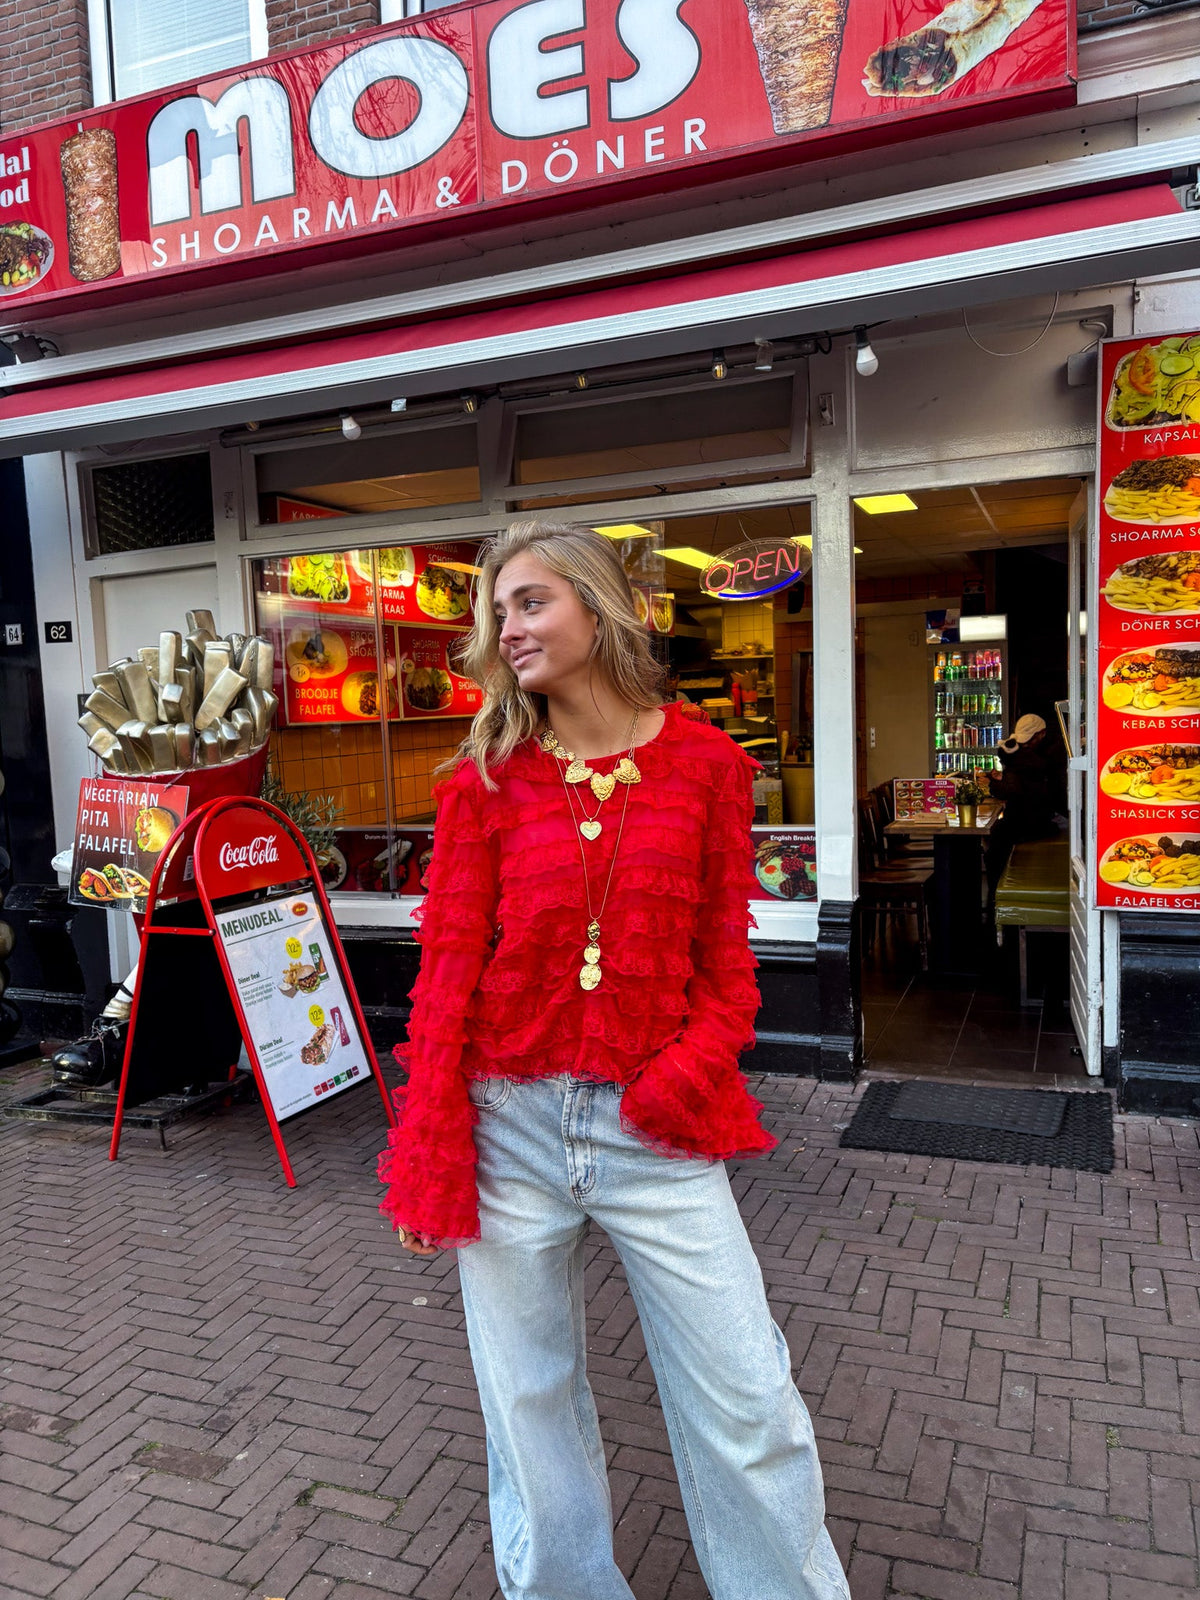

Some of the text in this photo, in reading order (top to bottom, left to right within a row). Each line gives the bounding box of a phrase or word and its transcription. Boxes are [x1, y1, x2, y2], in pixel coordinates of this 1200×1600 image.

[147, 0, 700, 227] MOES
[152, 117, 708, 267] SHOARMA & DÖNER
[1110, 526, 1200, 543] SHOARMA S
[705, 545, 800, 592] OPEN
[384, 603, 405, 615] KAAS
[50, 625, 67, 640] 62
[1121, 619, 1170, 632] DÖNER
[9, 627, 20, 642] 64
[295, 688, 338, 699] BROODJE
[300, 704, 336, 715] FALAFEL
[1122, 718, 1200, 730] KEBAB SCH
[84, 786, 159, 807] VEGETARIAN
[81, 809, 109, 827] PITA
[1110, 808, 1176, 820] SHASLICK
[79, 833, 135, 856] FALAFEL
[1115, 896, 1200, 909] FALAFEL SCH
[221, 908, 284, 938] MENUDEAL
